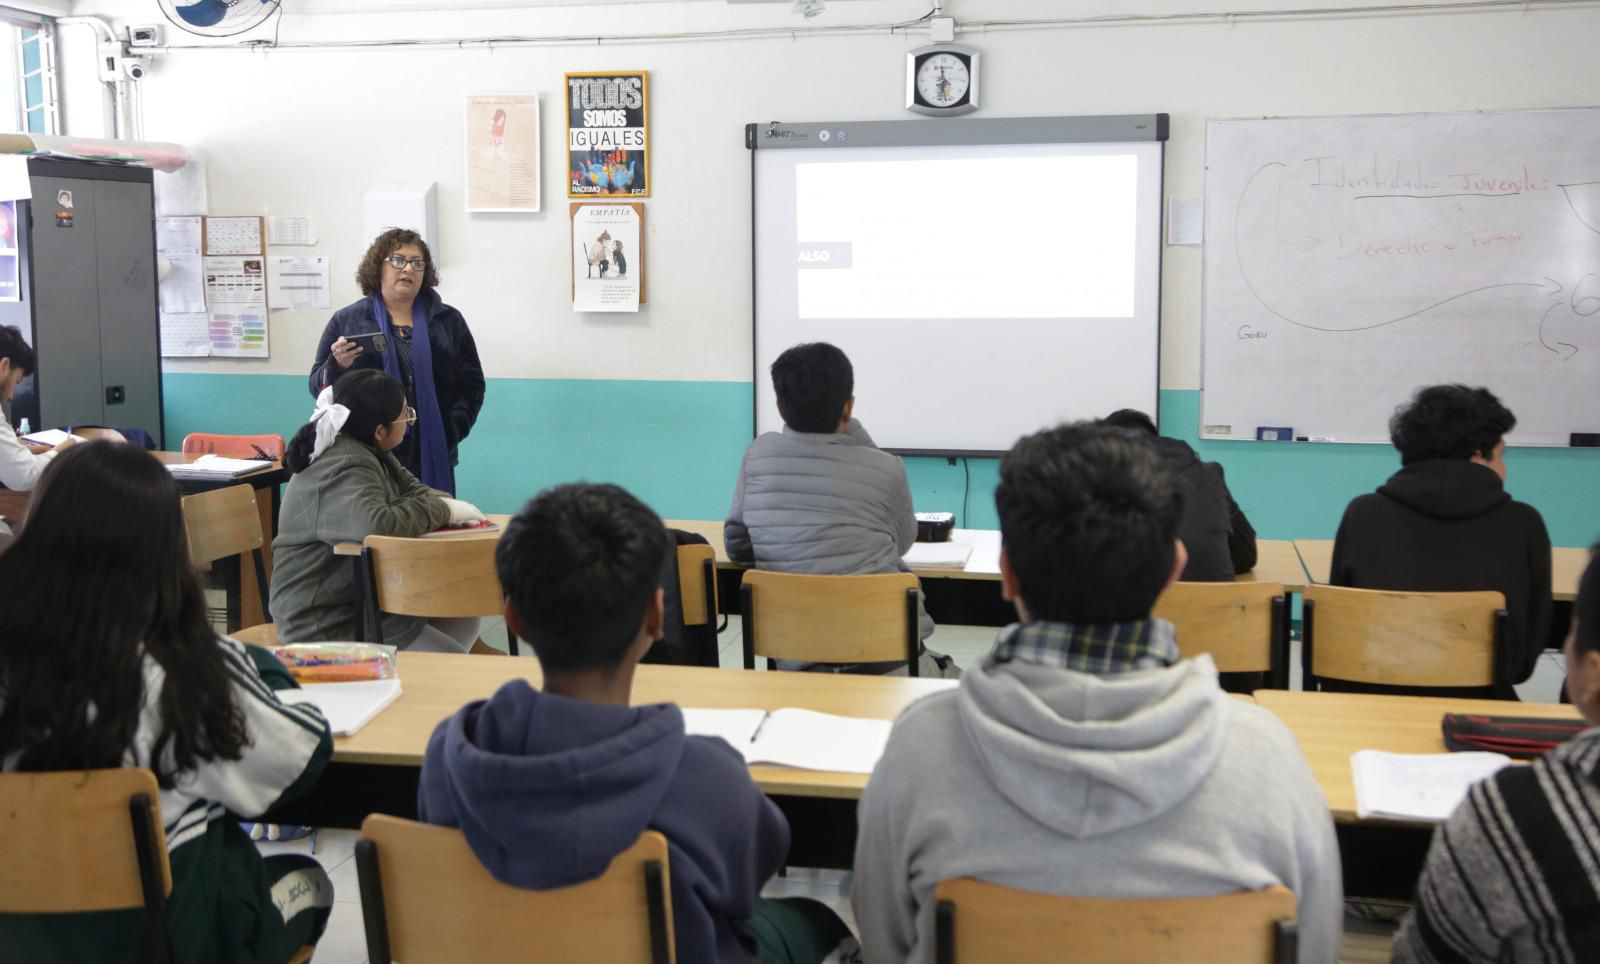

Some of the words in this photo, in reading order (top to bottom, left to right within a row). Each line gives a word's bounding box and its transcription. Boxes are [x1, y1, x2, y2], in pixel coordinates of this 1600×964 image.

[569, 77, 643, 110] TODOS
[583, 110, 627, 127] SOMOS
[571, 131, 644, 146] IGUALES
[571, 185, 601, 193] RACISMO
[798, 249, 831, 262] ALSO
